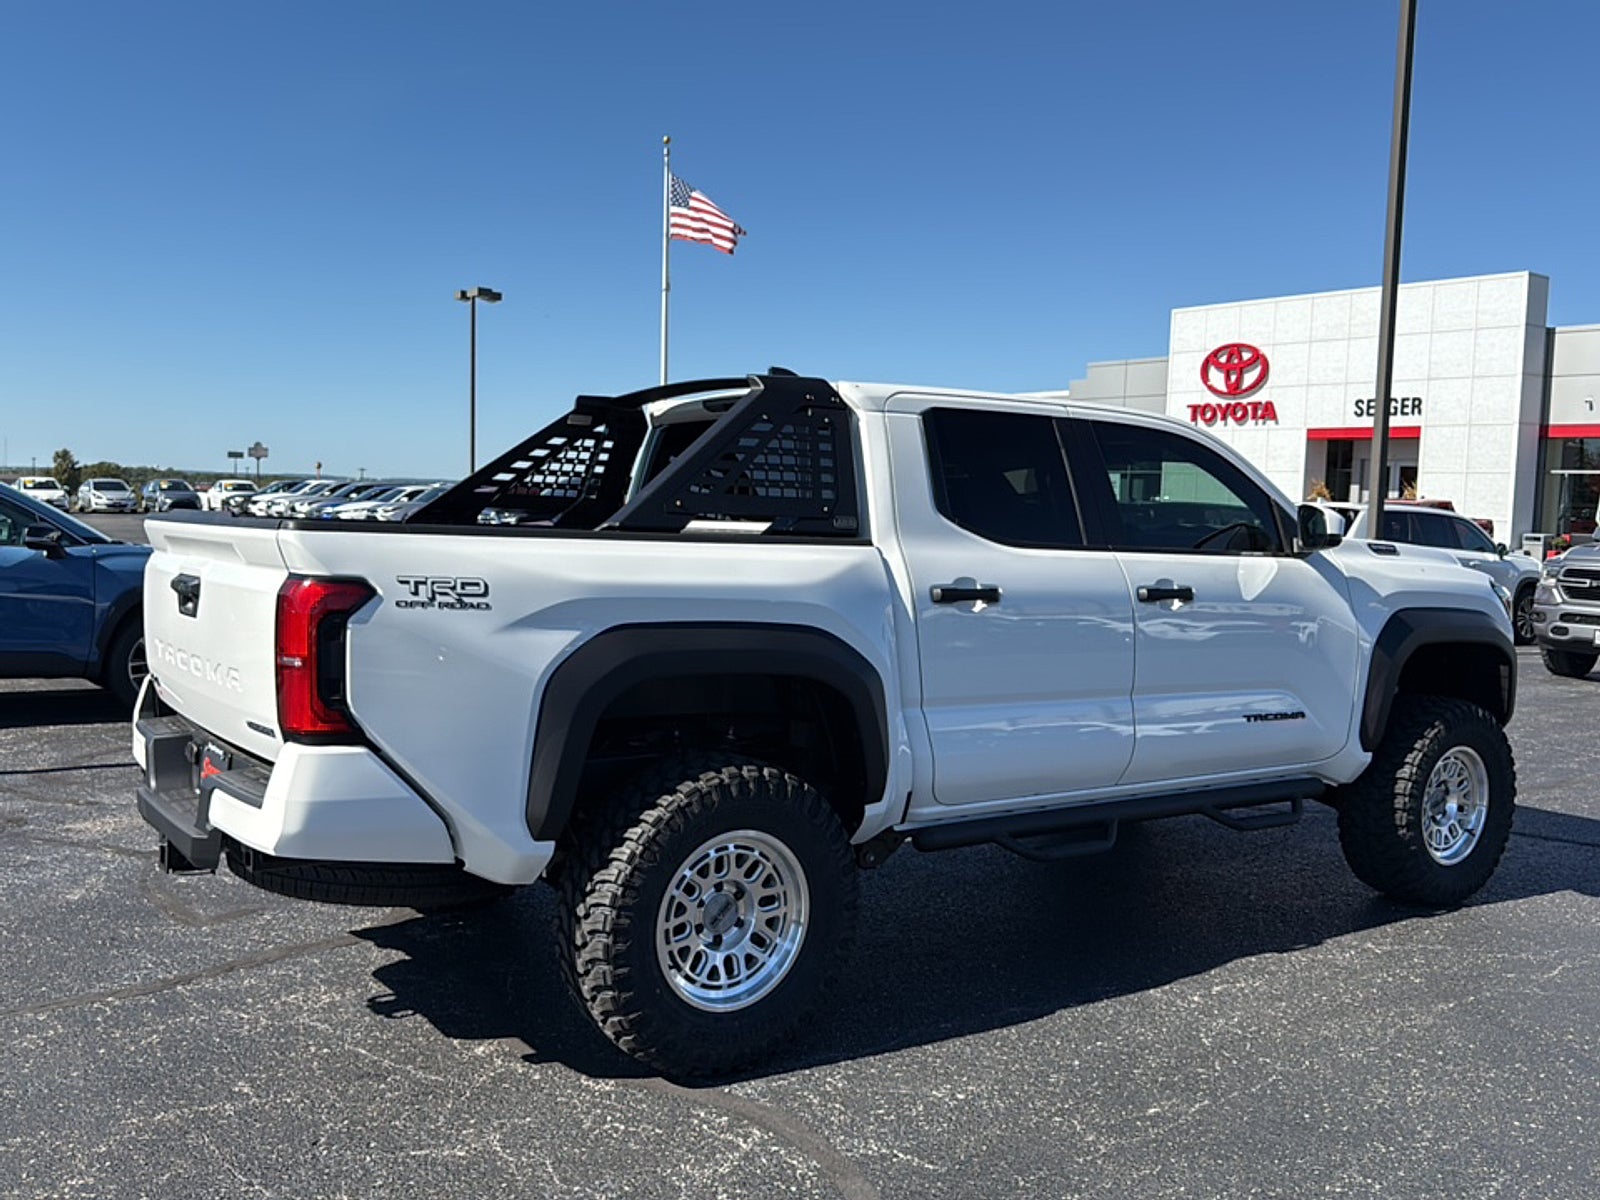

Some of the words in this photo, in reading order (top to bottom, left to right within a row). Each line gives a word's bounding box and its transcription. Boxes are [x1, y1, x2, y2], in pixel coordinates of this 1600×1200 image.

[1187, 400, 1278, 426] TOYOTA
[1353, 396, 1423, 418] SEGER
[396, 575, 490, 602] TRD
[395, 600, 436, 610] OFF
[438, 601, 493, 611] ROAD
[154, 636, 243, 693] TACOMA
[1242, 711, 1306, 723] TACOMA
